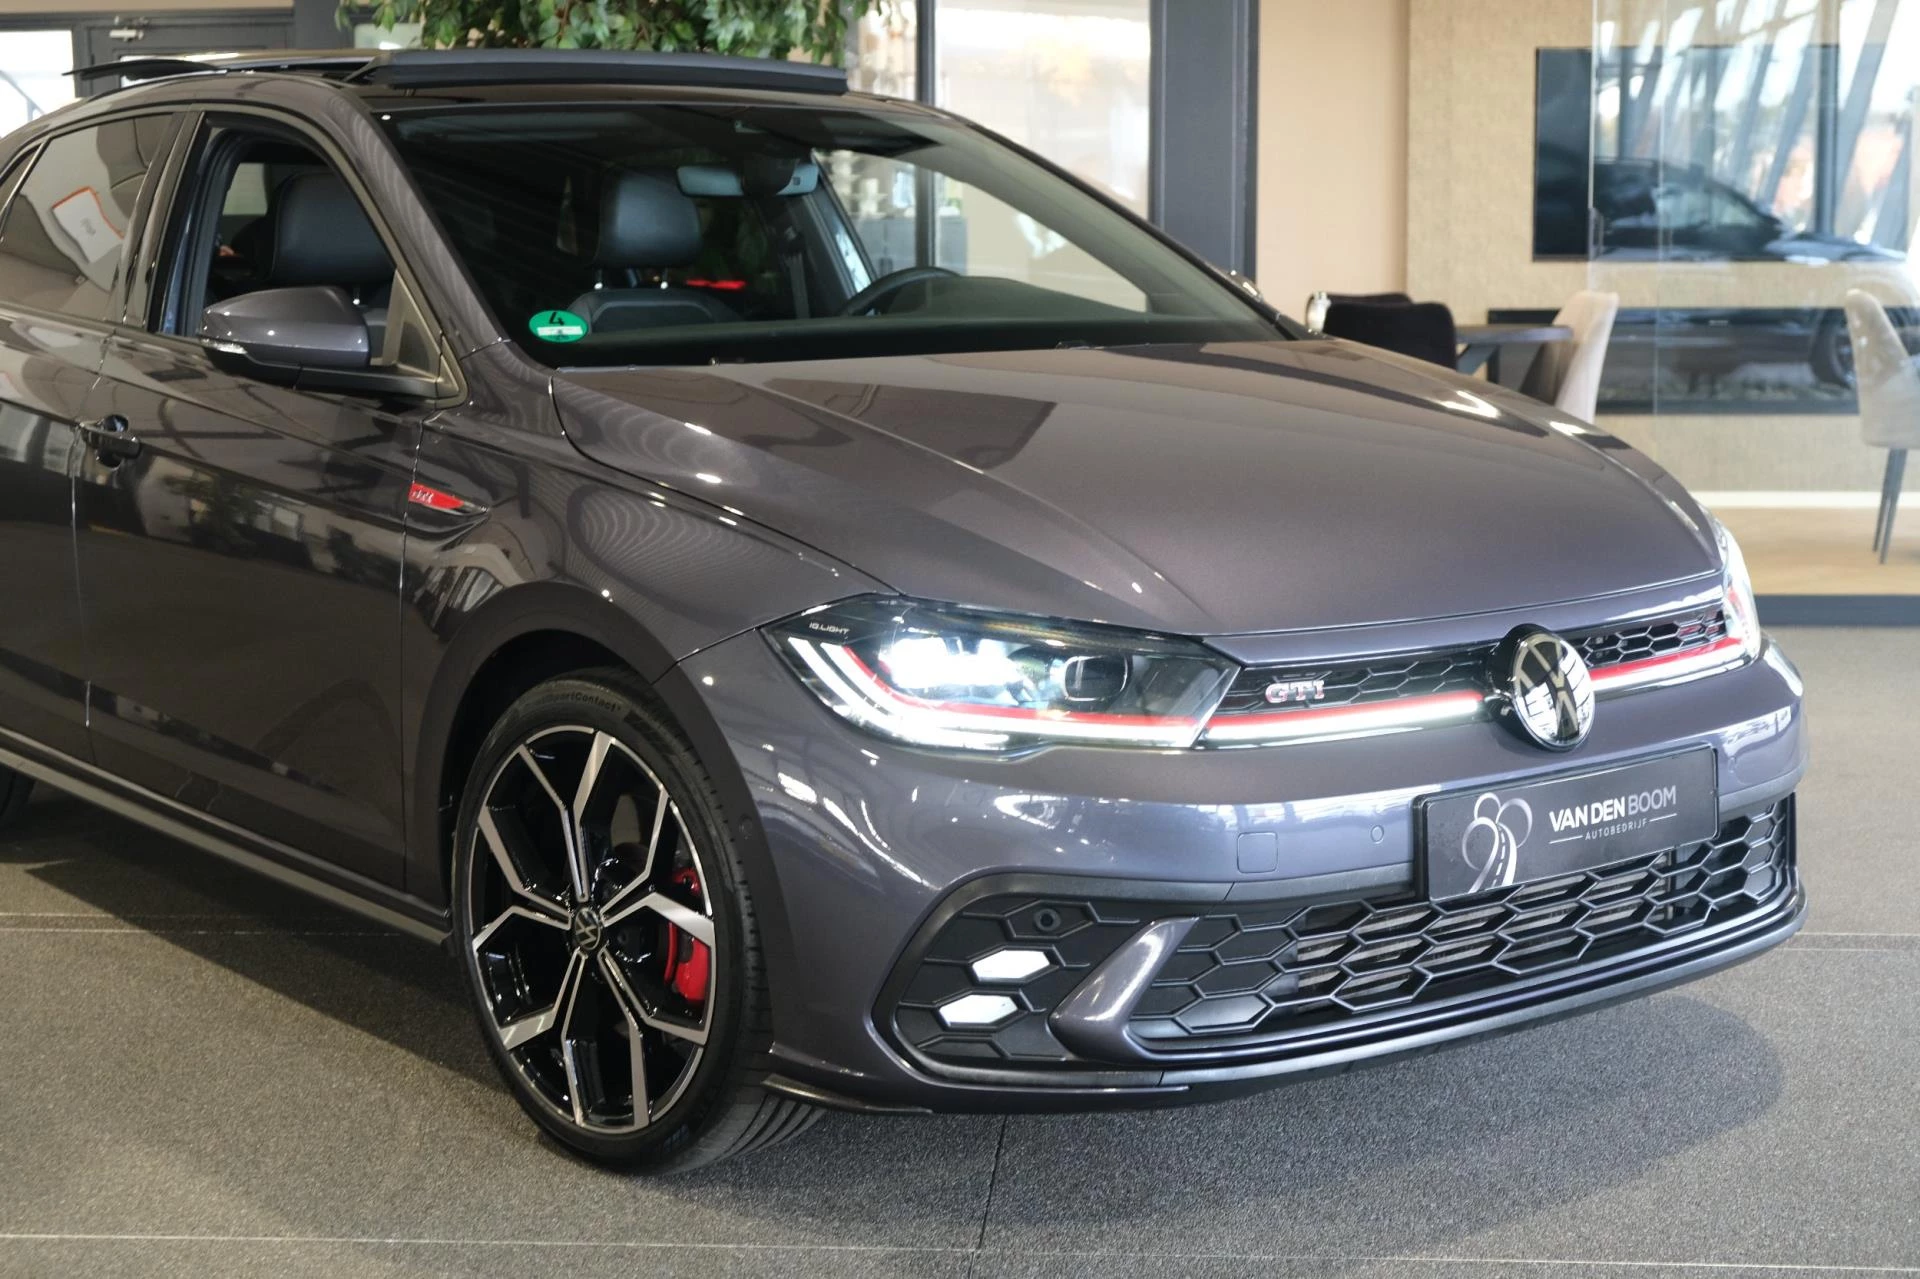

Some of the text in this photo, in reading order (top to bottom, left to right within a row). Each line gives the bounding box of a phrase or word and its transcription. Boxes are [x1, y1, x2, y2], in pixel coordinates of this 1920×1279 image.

[549, 311, 565, 326] 4
[1265, 680, 1325, 704] GTI
[1549, 785, 1677, 832] VAN DEN BOOM
[1585, 817, 1648, 841] AUTOBEDRIJF
